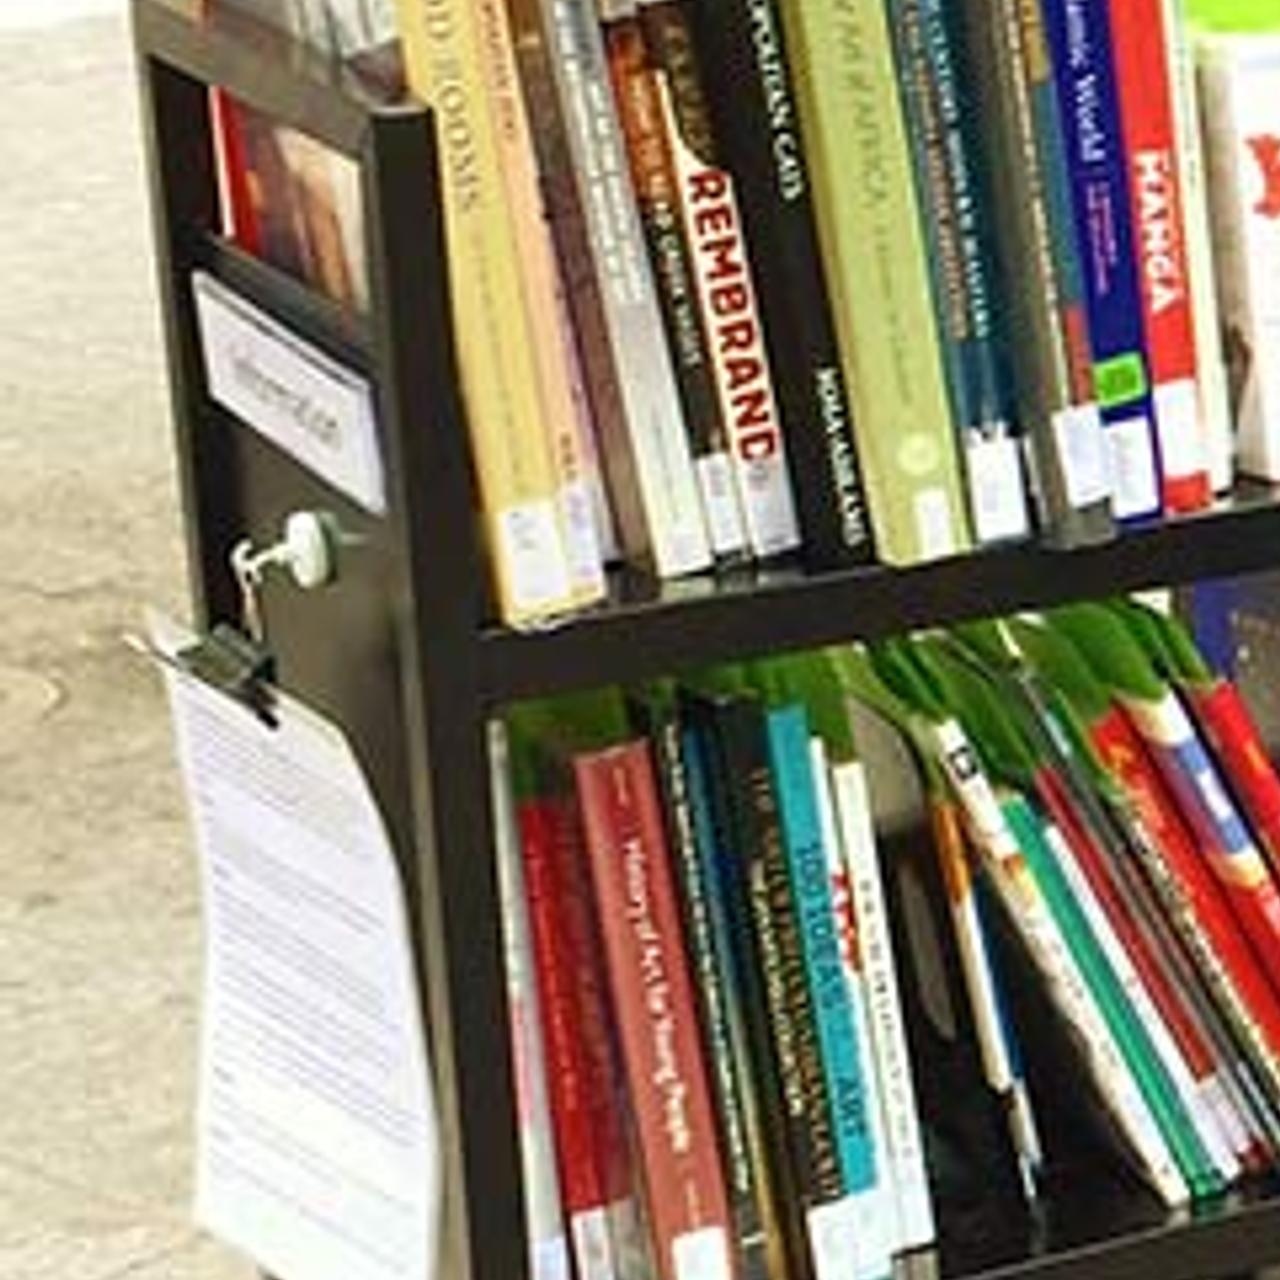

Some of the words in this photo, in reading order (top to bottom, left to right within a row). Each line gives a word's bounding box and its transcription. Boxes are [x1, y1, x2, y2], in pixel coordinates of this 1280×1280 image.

[435, 56, 482, 212] ROOMS
[1072, 75, 1107, 161] World
[1130, 150, 1181, 311] MANGA
[686, 170, 780, 463] REMBRAND
